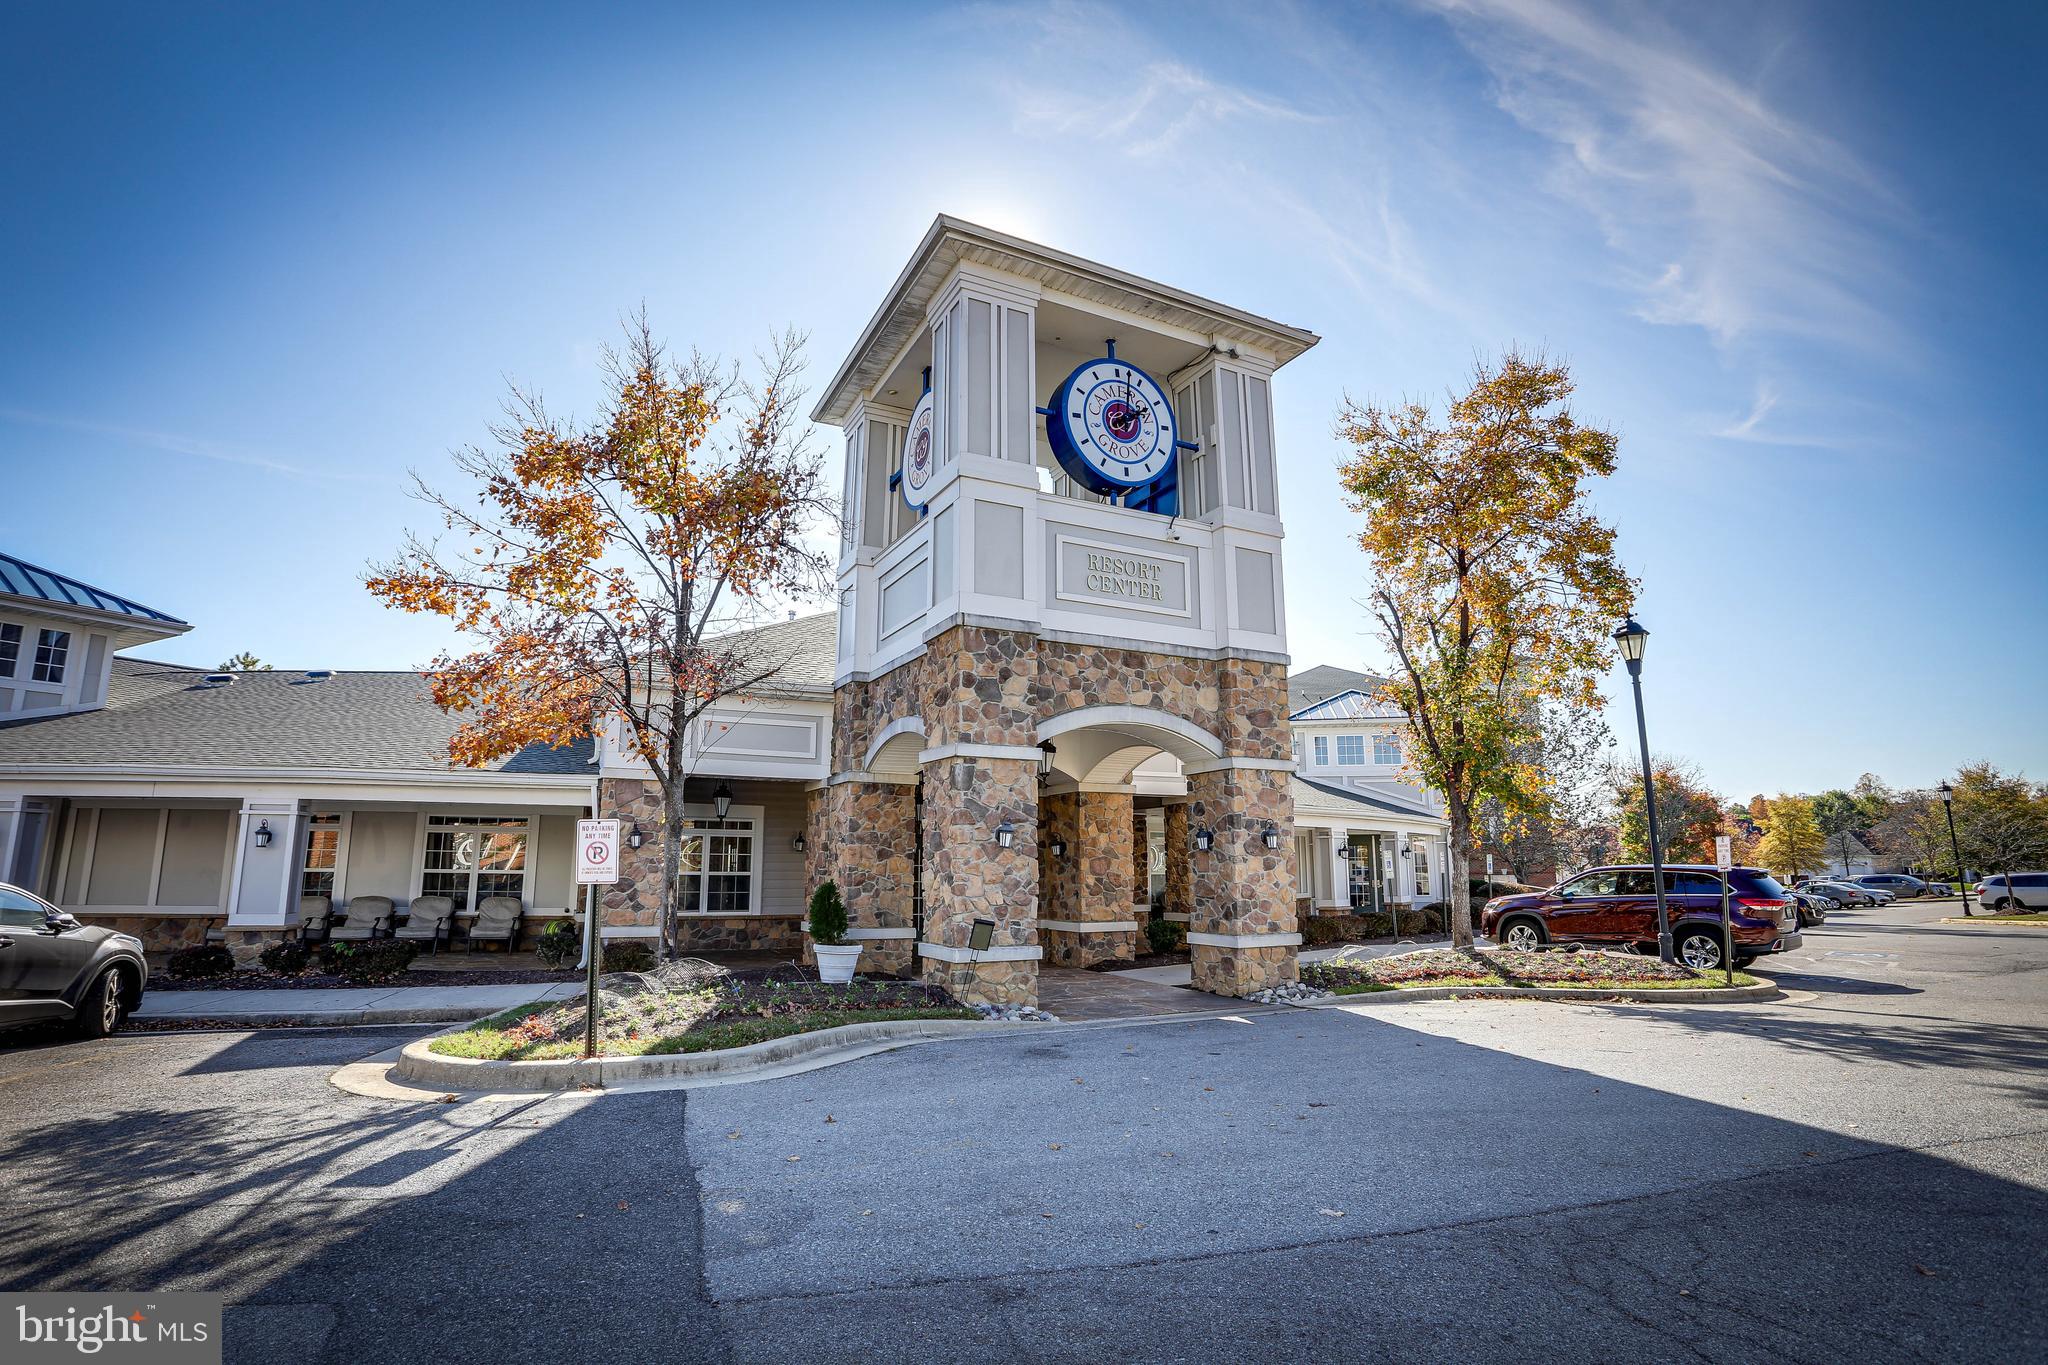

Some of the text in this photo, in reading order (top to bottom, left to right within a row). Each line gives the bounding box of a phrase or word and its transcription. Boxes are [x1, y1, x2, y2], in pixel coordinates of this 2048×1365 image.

[1098, 433, 1149, 459] GROVE
[1087, 553, 1161, 581] RESORT
[1087, 574, 1163, 600] CENTER
